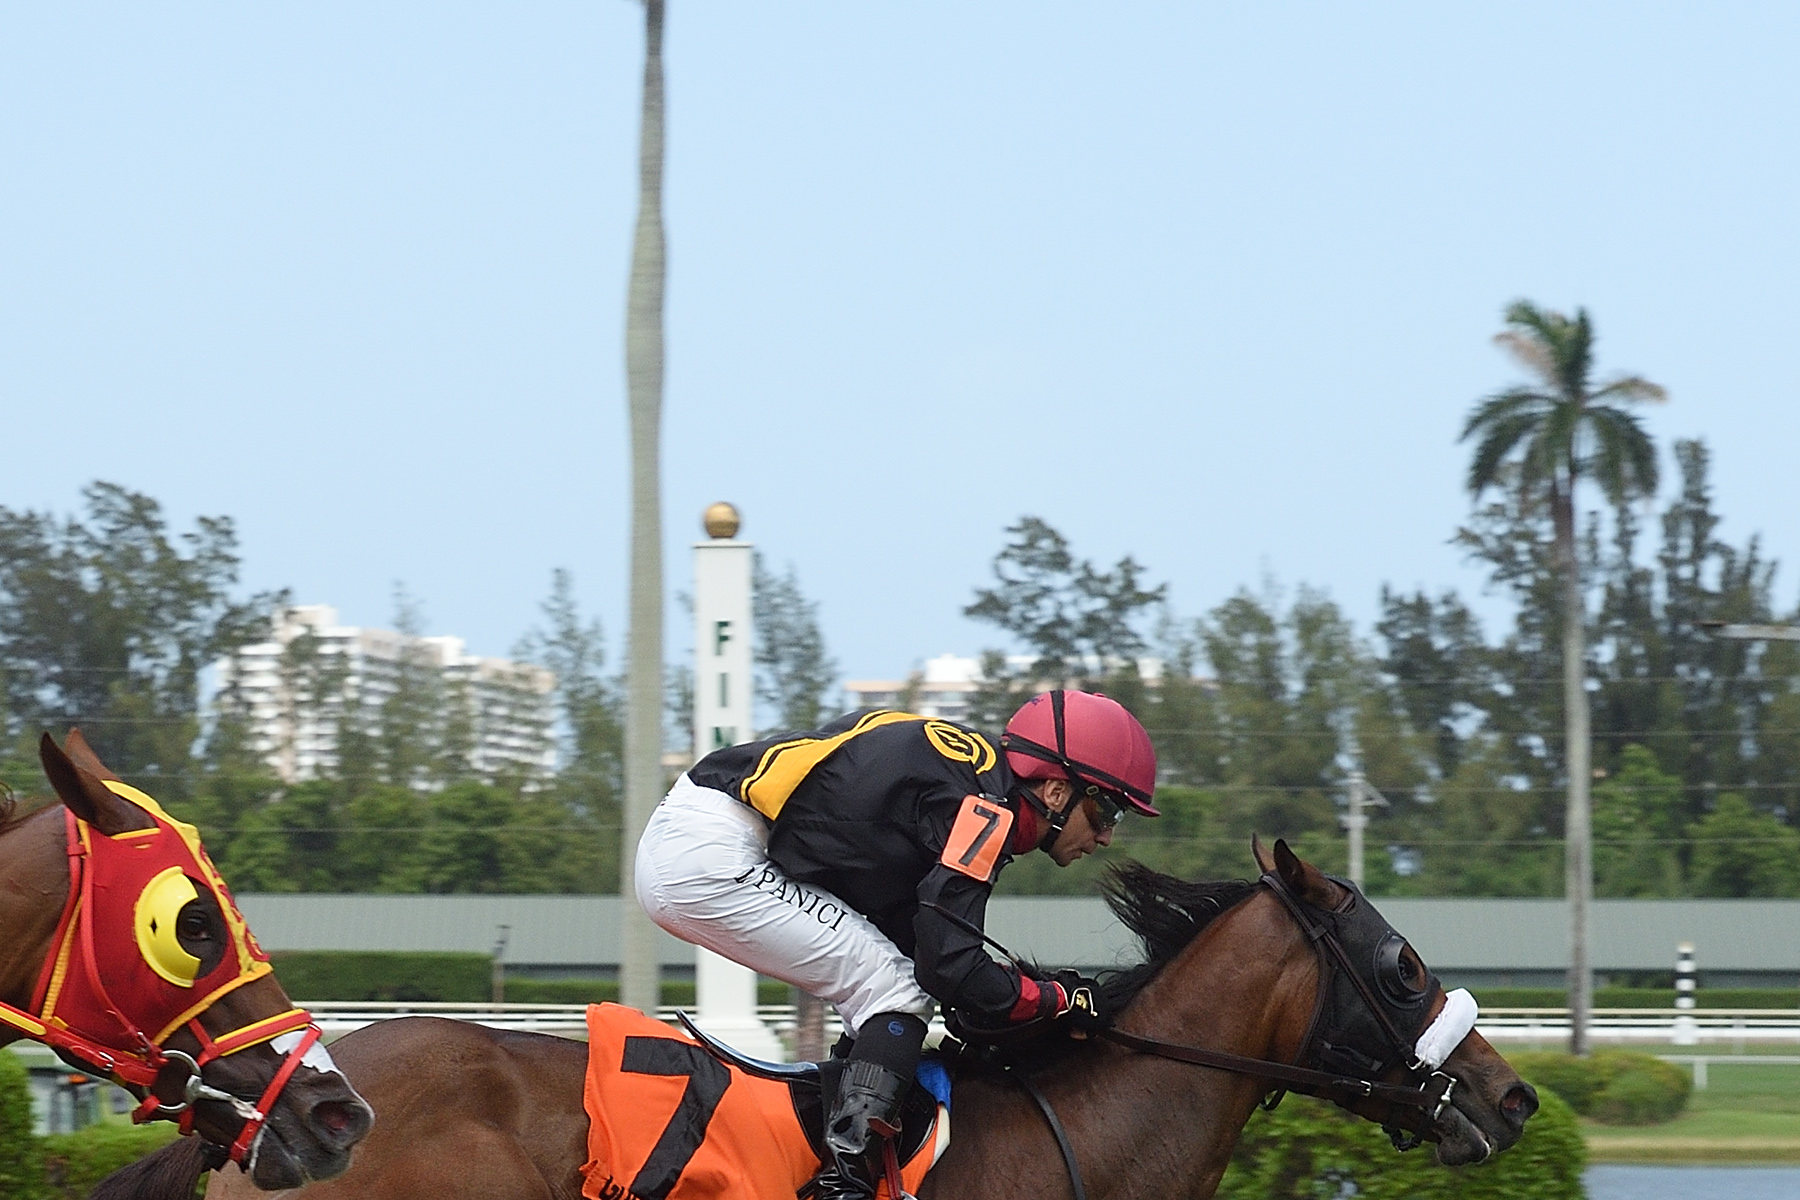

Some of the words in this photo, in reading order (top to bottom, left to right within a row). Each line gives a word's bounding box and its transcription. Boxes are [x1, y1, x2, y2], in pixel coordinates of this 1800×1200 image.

[711, 620, 737, 749] FIN
[958, 803, 1001, 867] 7
[752, 868, 849, 932] PANICI
